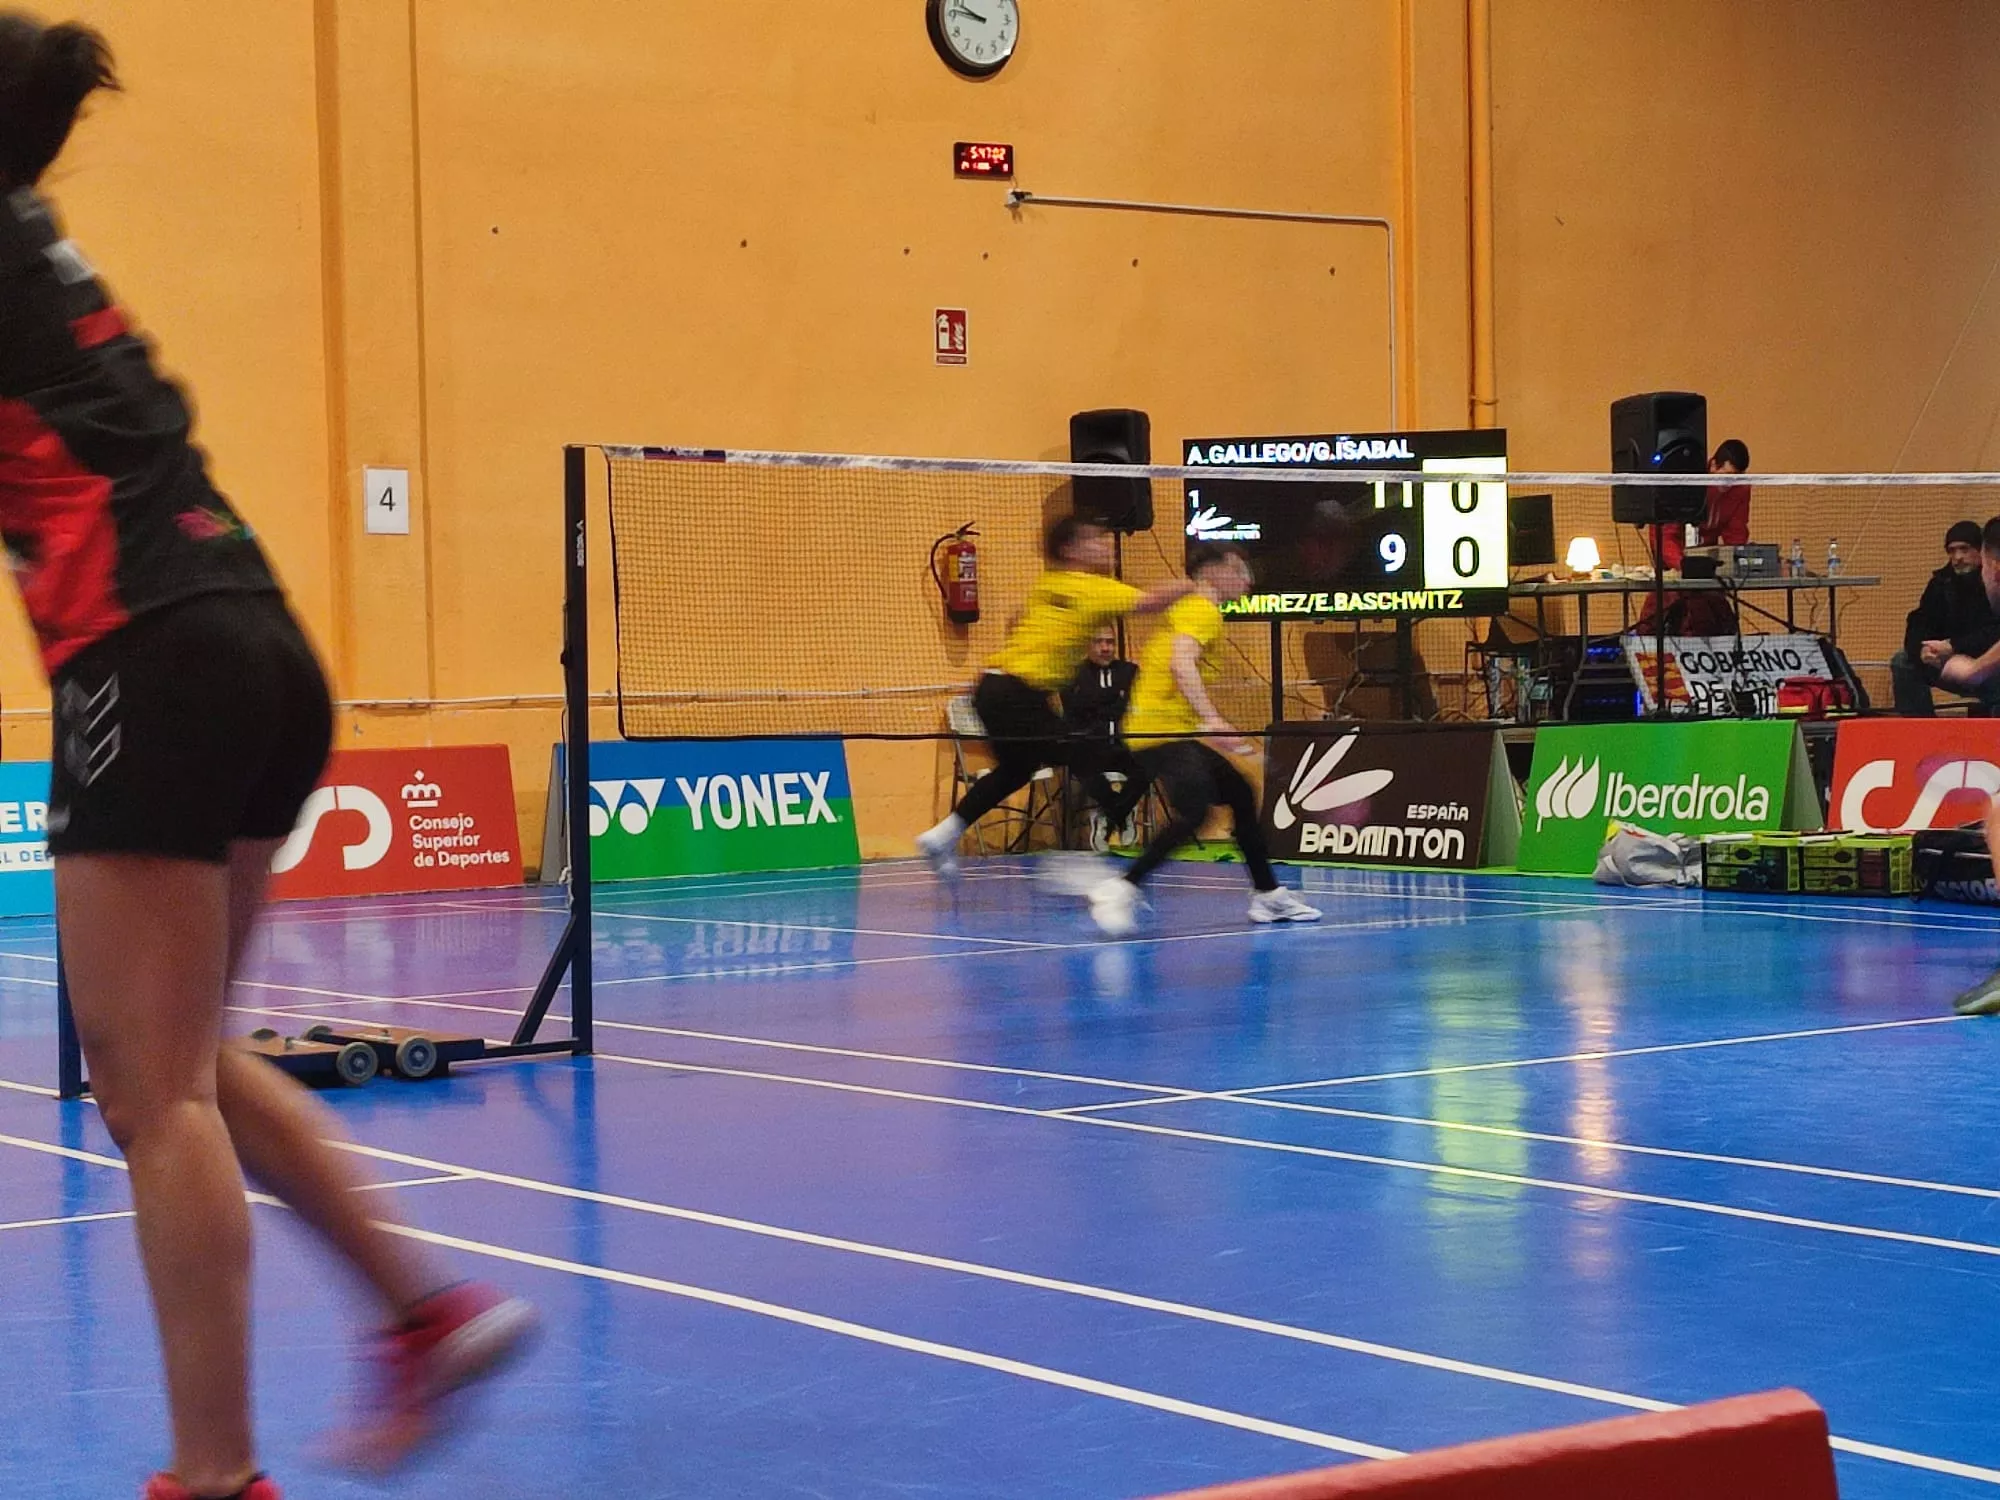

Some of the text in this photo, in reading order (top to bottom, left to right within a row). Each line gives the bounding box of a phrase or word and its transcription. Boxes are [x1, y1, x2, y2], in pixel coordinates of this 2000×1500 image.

[379, 486, 396, 512] 4
[1188, 489, 1199, 508] 1
[1379, 533, 1480, 578] 9 0
[675, 771, 837, 831] YONEX
[1603, 771, 1770, 822] Iberdrola
[409, 812, 475, 836] Consejo
[412, 831, 481, 851] Superior
[1299, 822, 1466, 860] BADMINTON
[413, 849, 511, 869] de Deportes
